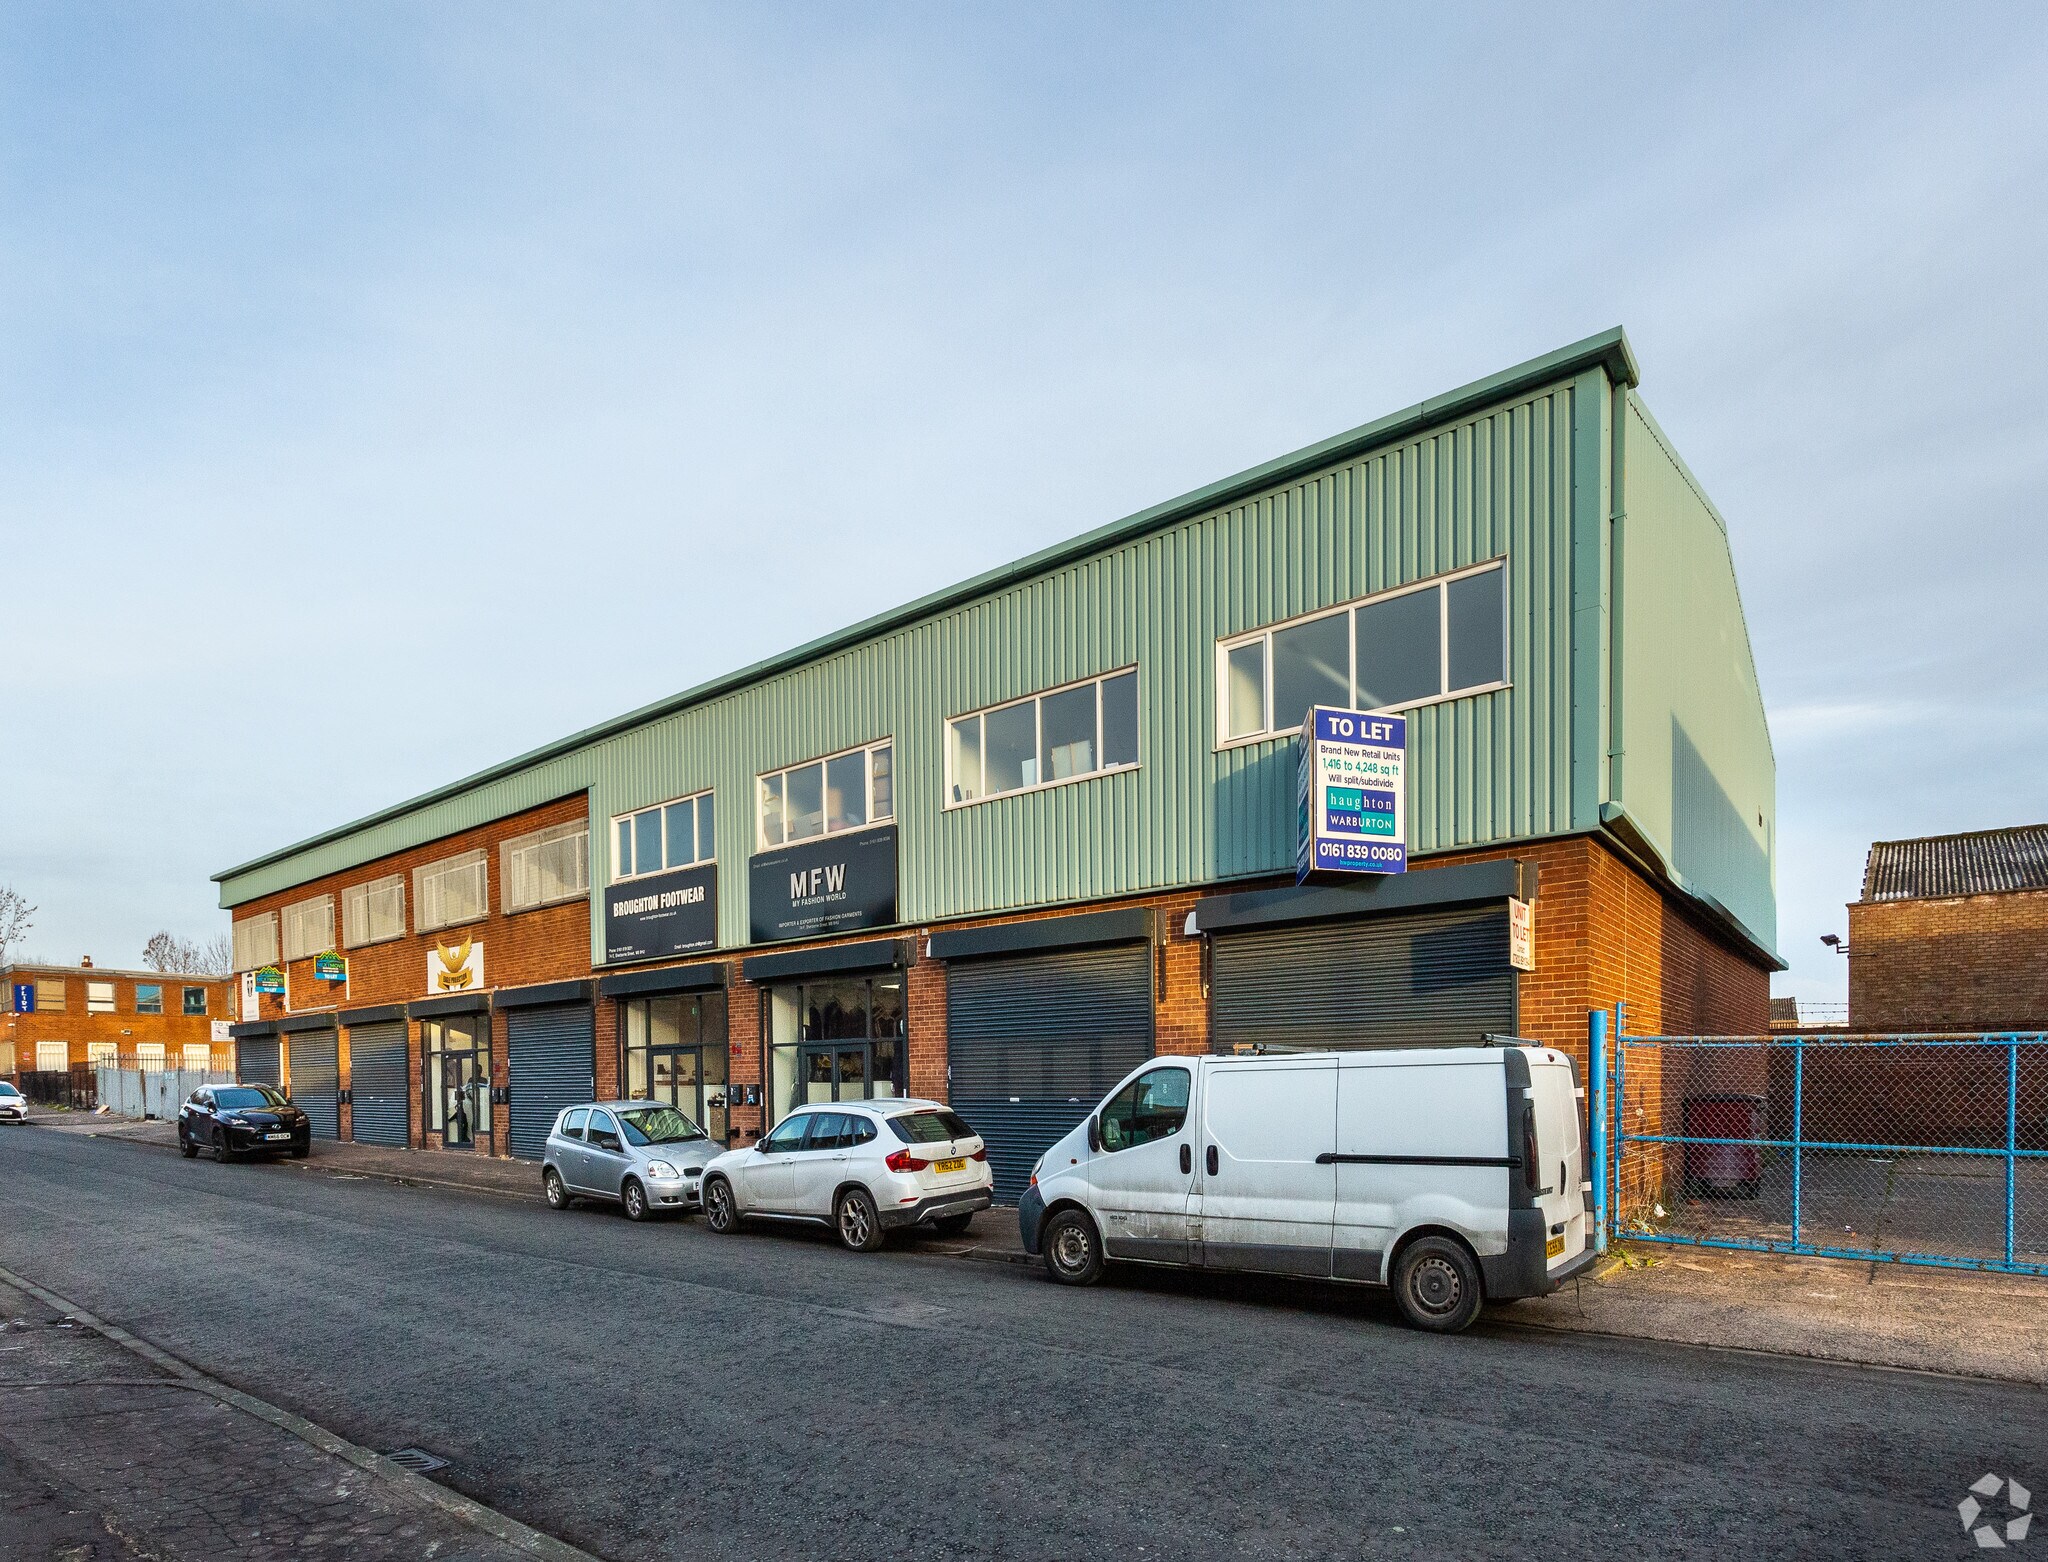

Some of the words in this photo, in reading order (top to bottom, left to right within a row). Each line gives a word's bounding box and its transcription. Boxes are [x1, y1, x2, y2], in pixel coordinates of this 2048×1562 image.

[1328, 717, 1354, 737] TO
[1360, 721, 1393, 741] LET
[1320, 745, 1342, 755] Brand
[1344, 747, 1360, 757] New
[1361, 749, 1381, 759] Retail
[1383, 751, 1400, 761] Units
[1322, 758, 1341, 771] 1,416
[1344, 761, 1353, 771] to
[1355, 761, 1378, 774] 4,248
[1380, 766, 1390, 776] sq
[1392, 765, 1399, 775] ft
[1328, 774, 1342, 783] Will
[1344, 775, 1394, 788] split/subdivide
[1330, 792, 1392, 810] haughton
[1330, 815, 1392, 829] WARBURTON
[1319, 842, 1344, 858] 0161
[1347, 844, 1369, 859] 839
[1371, 846, 1402, 862] 0080
[1339, 859, 1383, 868] hwproperty.co.uk
[790, 863, 847, 900] MFW
[613, 894, 659, 918] BROUGHTON
[660, 886, 705, 909] FOOTWEAR
[792, 900, 800, 908] MY
[801, 896, 825, 906] FASHION
[826, 892, 847, 901] WORLD
[1513, 903, 1526, 922] UNIT
[1512, 922, 1519, 940] TO
